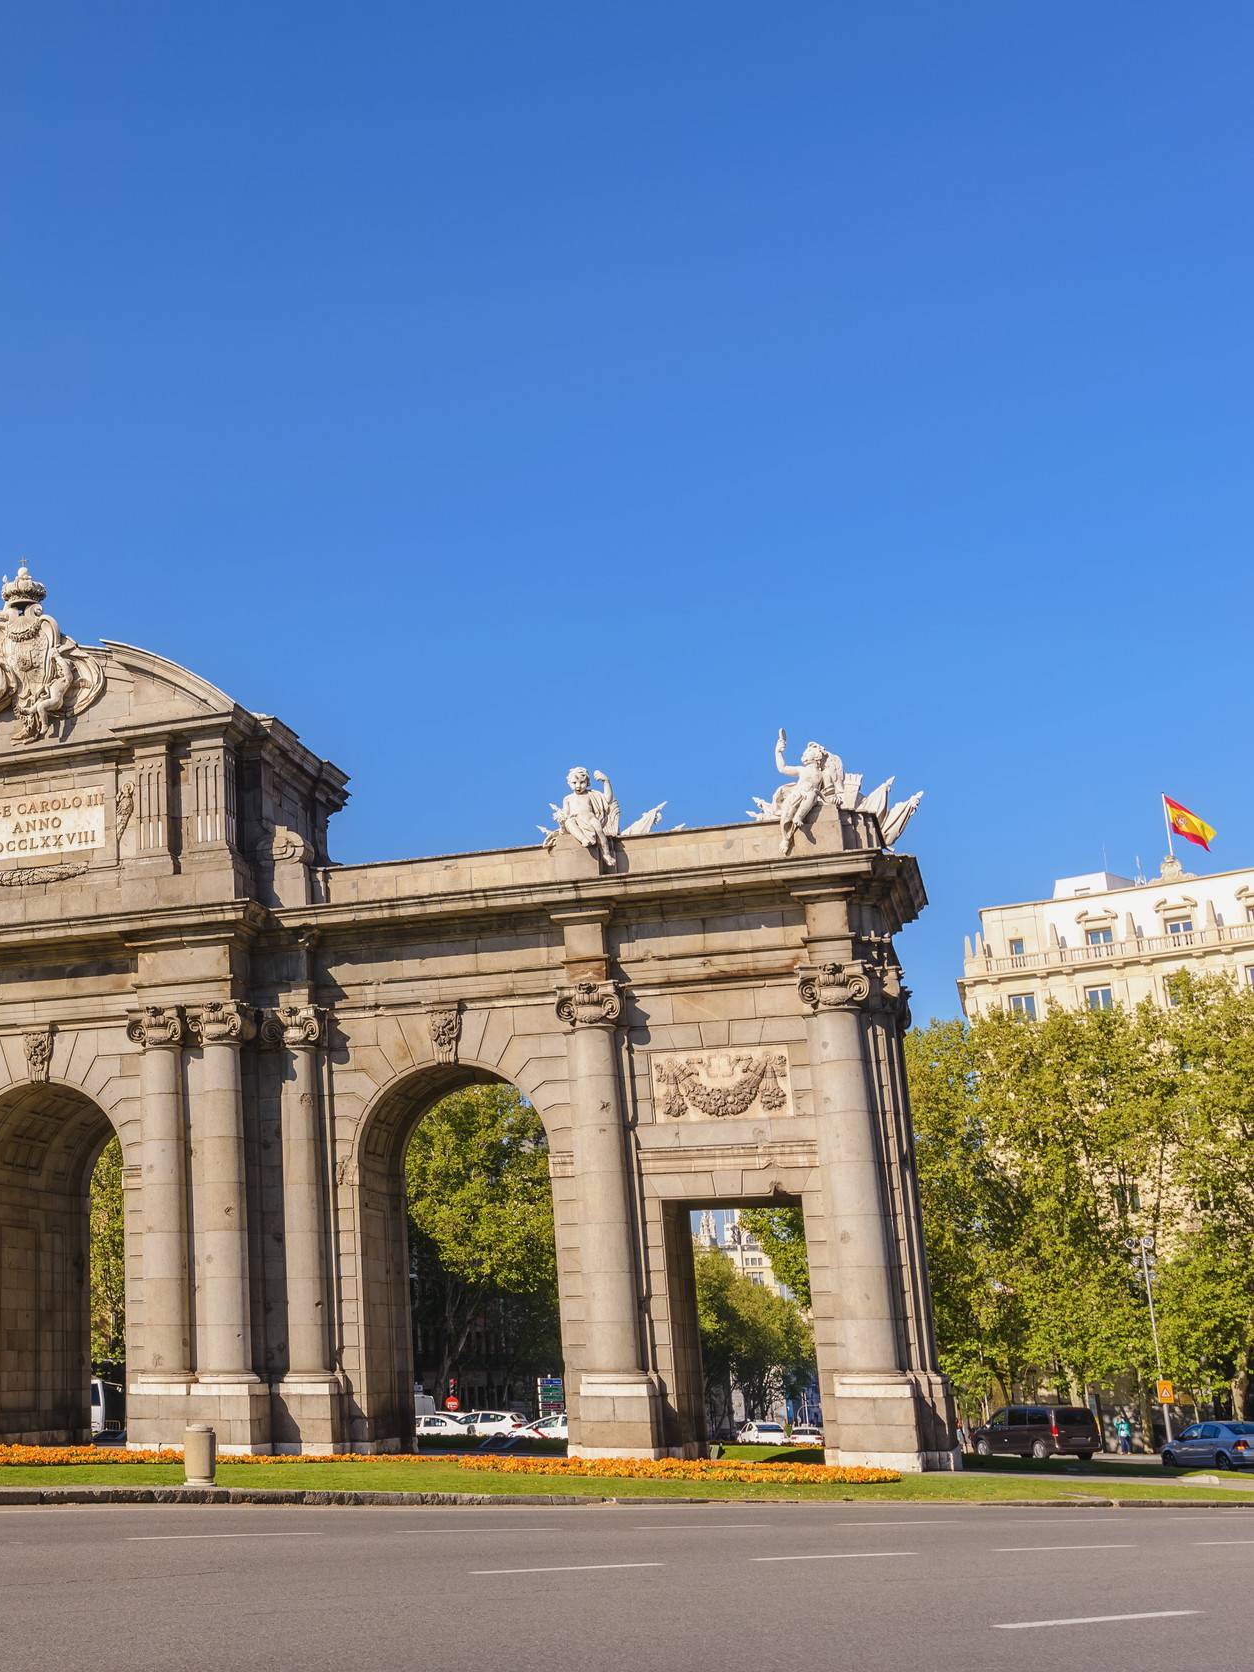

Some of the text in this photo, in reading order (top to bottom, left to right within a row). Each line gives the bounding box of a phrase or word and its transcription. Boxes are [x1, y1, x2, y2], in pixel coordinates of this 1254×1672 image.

[17, 796, 83, 815] CAROLO
[87, 793, 106, 807] III
[12, 817, 62, 834] ANNO
